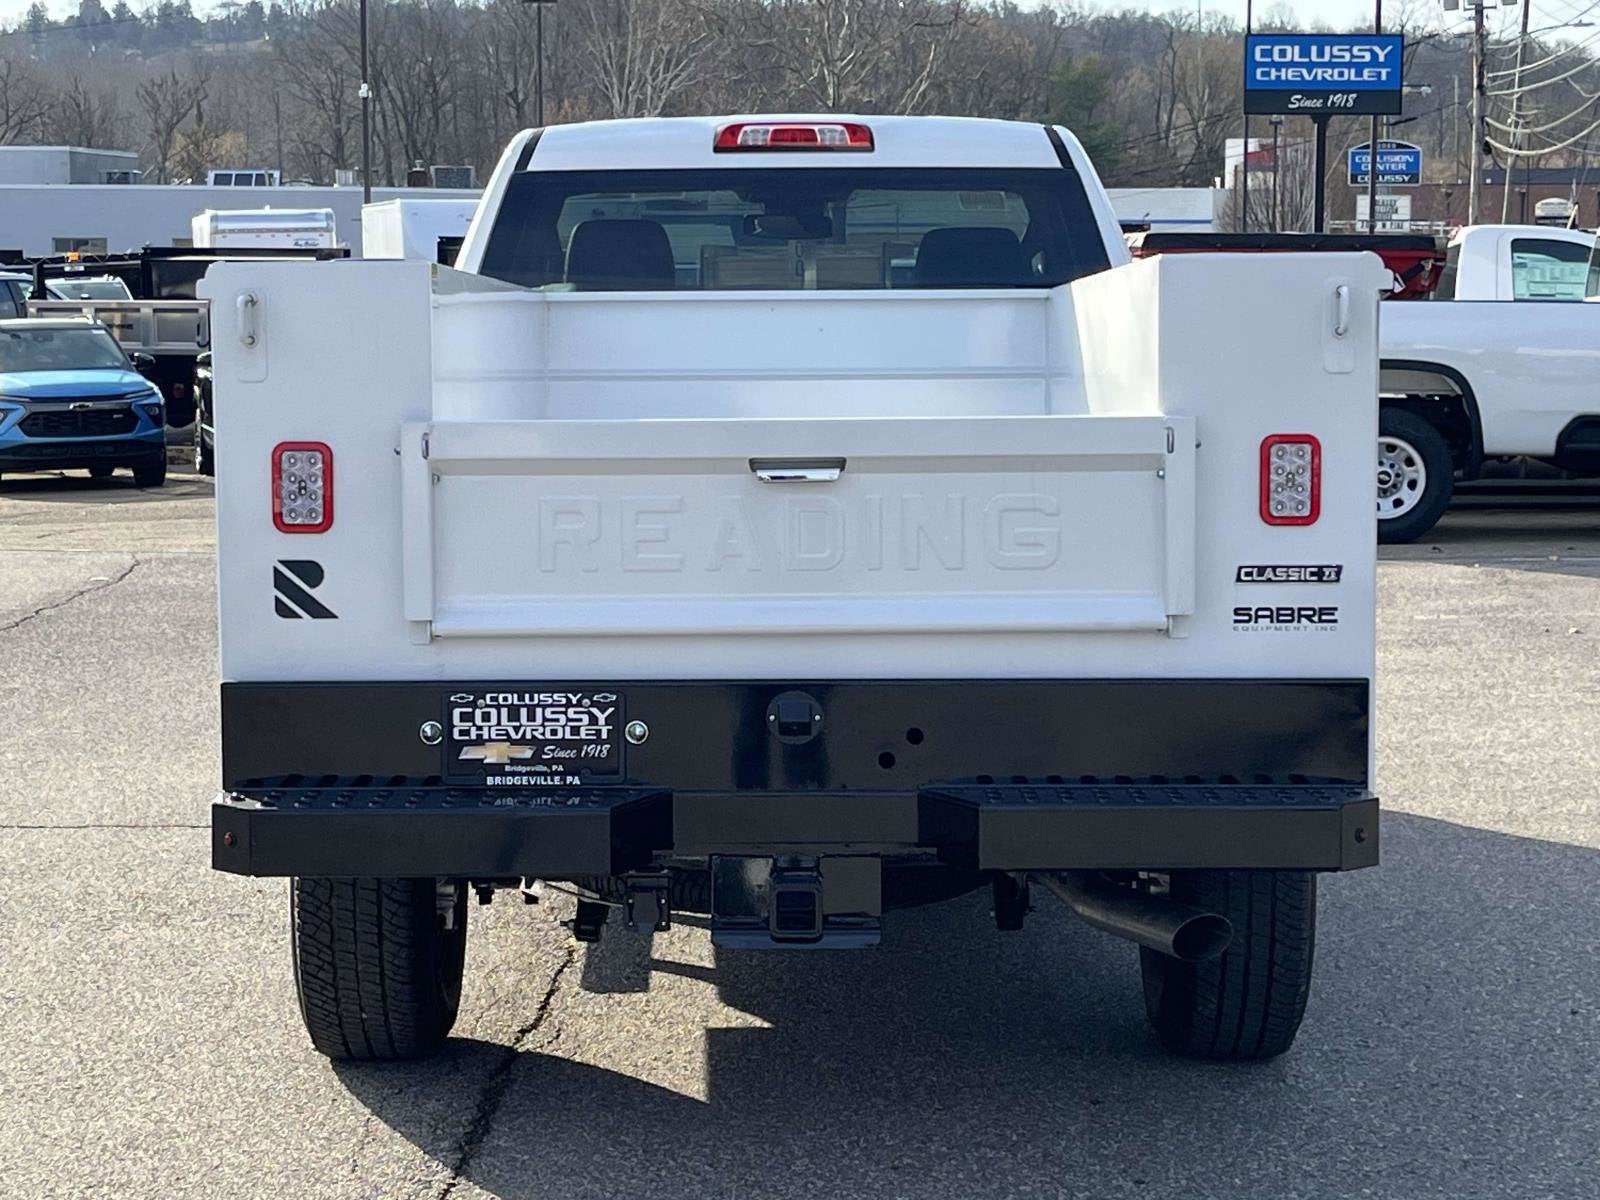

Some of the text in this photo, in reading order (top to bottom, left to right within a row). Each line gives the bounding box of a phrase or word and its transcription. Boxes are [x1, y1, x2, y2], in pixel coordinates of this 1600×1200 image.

[1254, 45, 1394, 63] COLUSSY
[1255, 67, 1392, 81] CHEVROLET
[1287, 93, 1358, 109] Since 1918
[1355, 154, 1414, 163] COLISION
[1361, 163, 1407, 171] CNTER
[1357, 174, 1412, 183] COUSSY
[536, 493, 1063, 574] READING
[1240, 567, 1318, 581] CLASSIC
[1233, 606, 1339, 624] SABRE
[485, 693, 583, 705] COLUSSY
[452, 707, 616, 727] COLUSSY
[452, 726, 614, 740] CHEVROLET
[541, 744, 612, 759] Since 1918
[566, 776, 581, 785] PA
